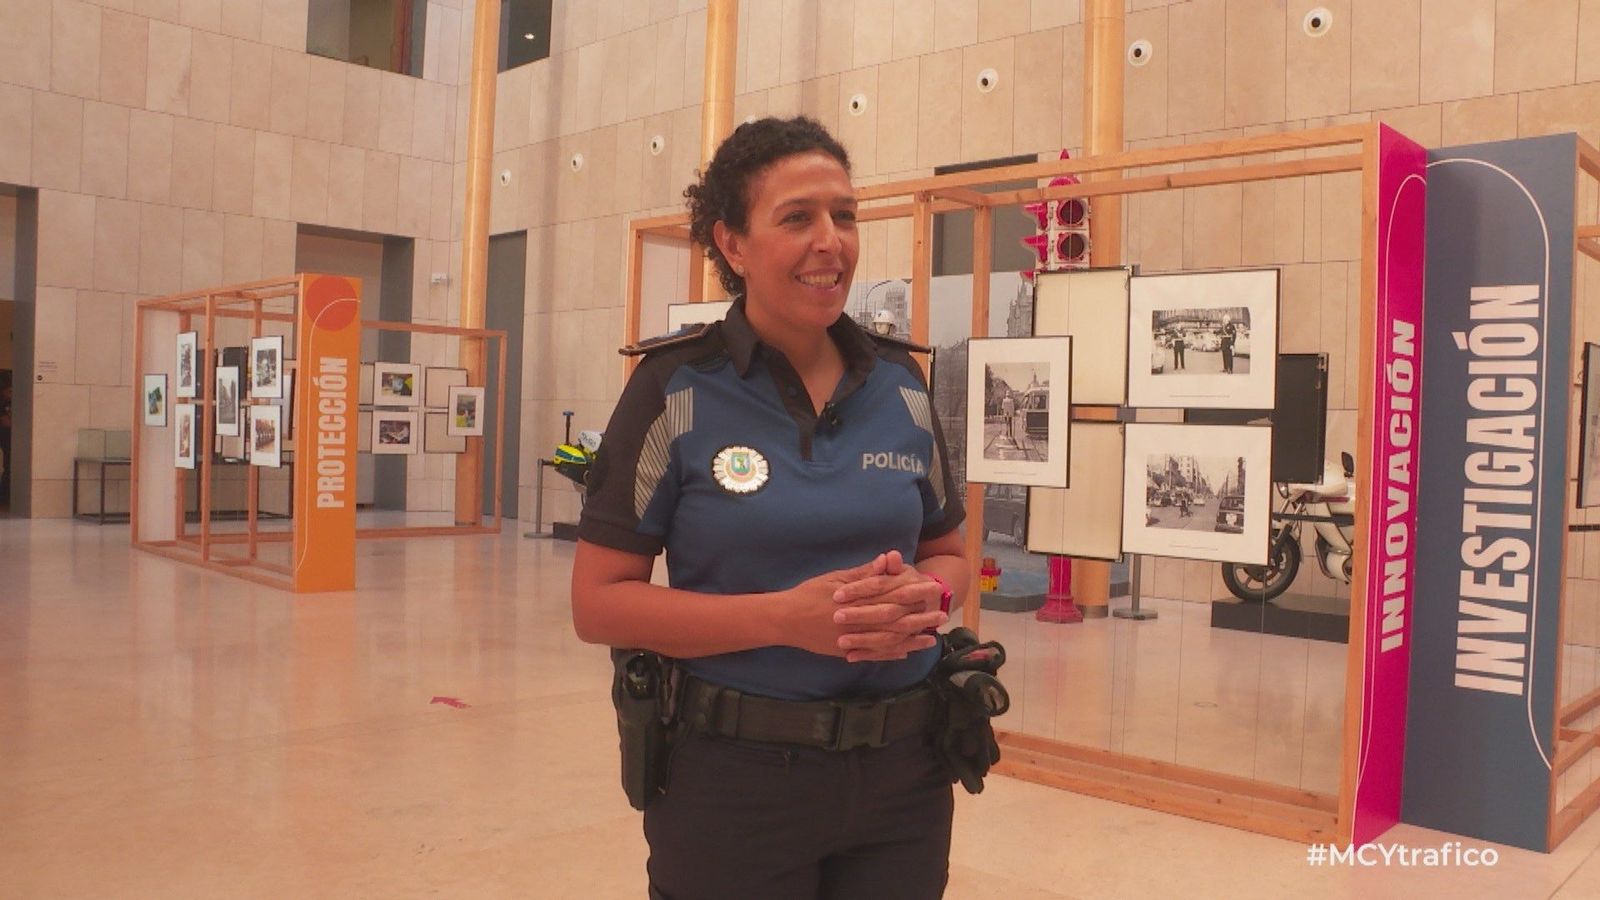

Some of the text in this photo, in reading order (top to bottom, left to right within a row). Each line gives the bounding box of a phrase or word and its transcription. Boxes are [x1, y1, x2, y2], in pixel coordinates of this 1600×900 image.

[312, 357, 348, 508] PROTECCIÓN
[862, 452, 926, 474] POLICÍA
[1381, 319, 1416, 653] INNOVACIÓN
[1451, 284, 1540, 696] INVESTIGACIÓN
